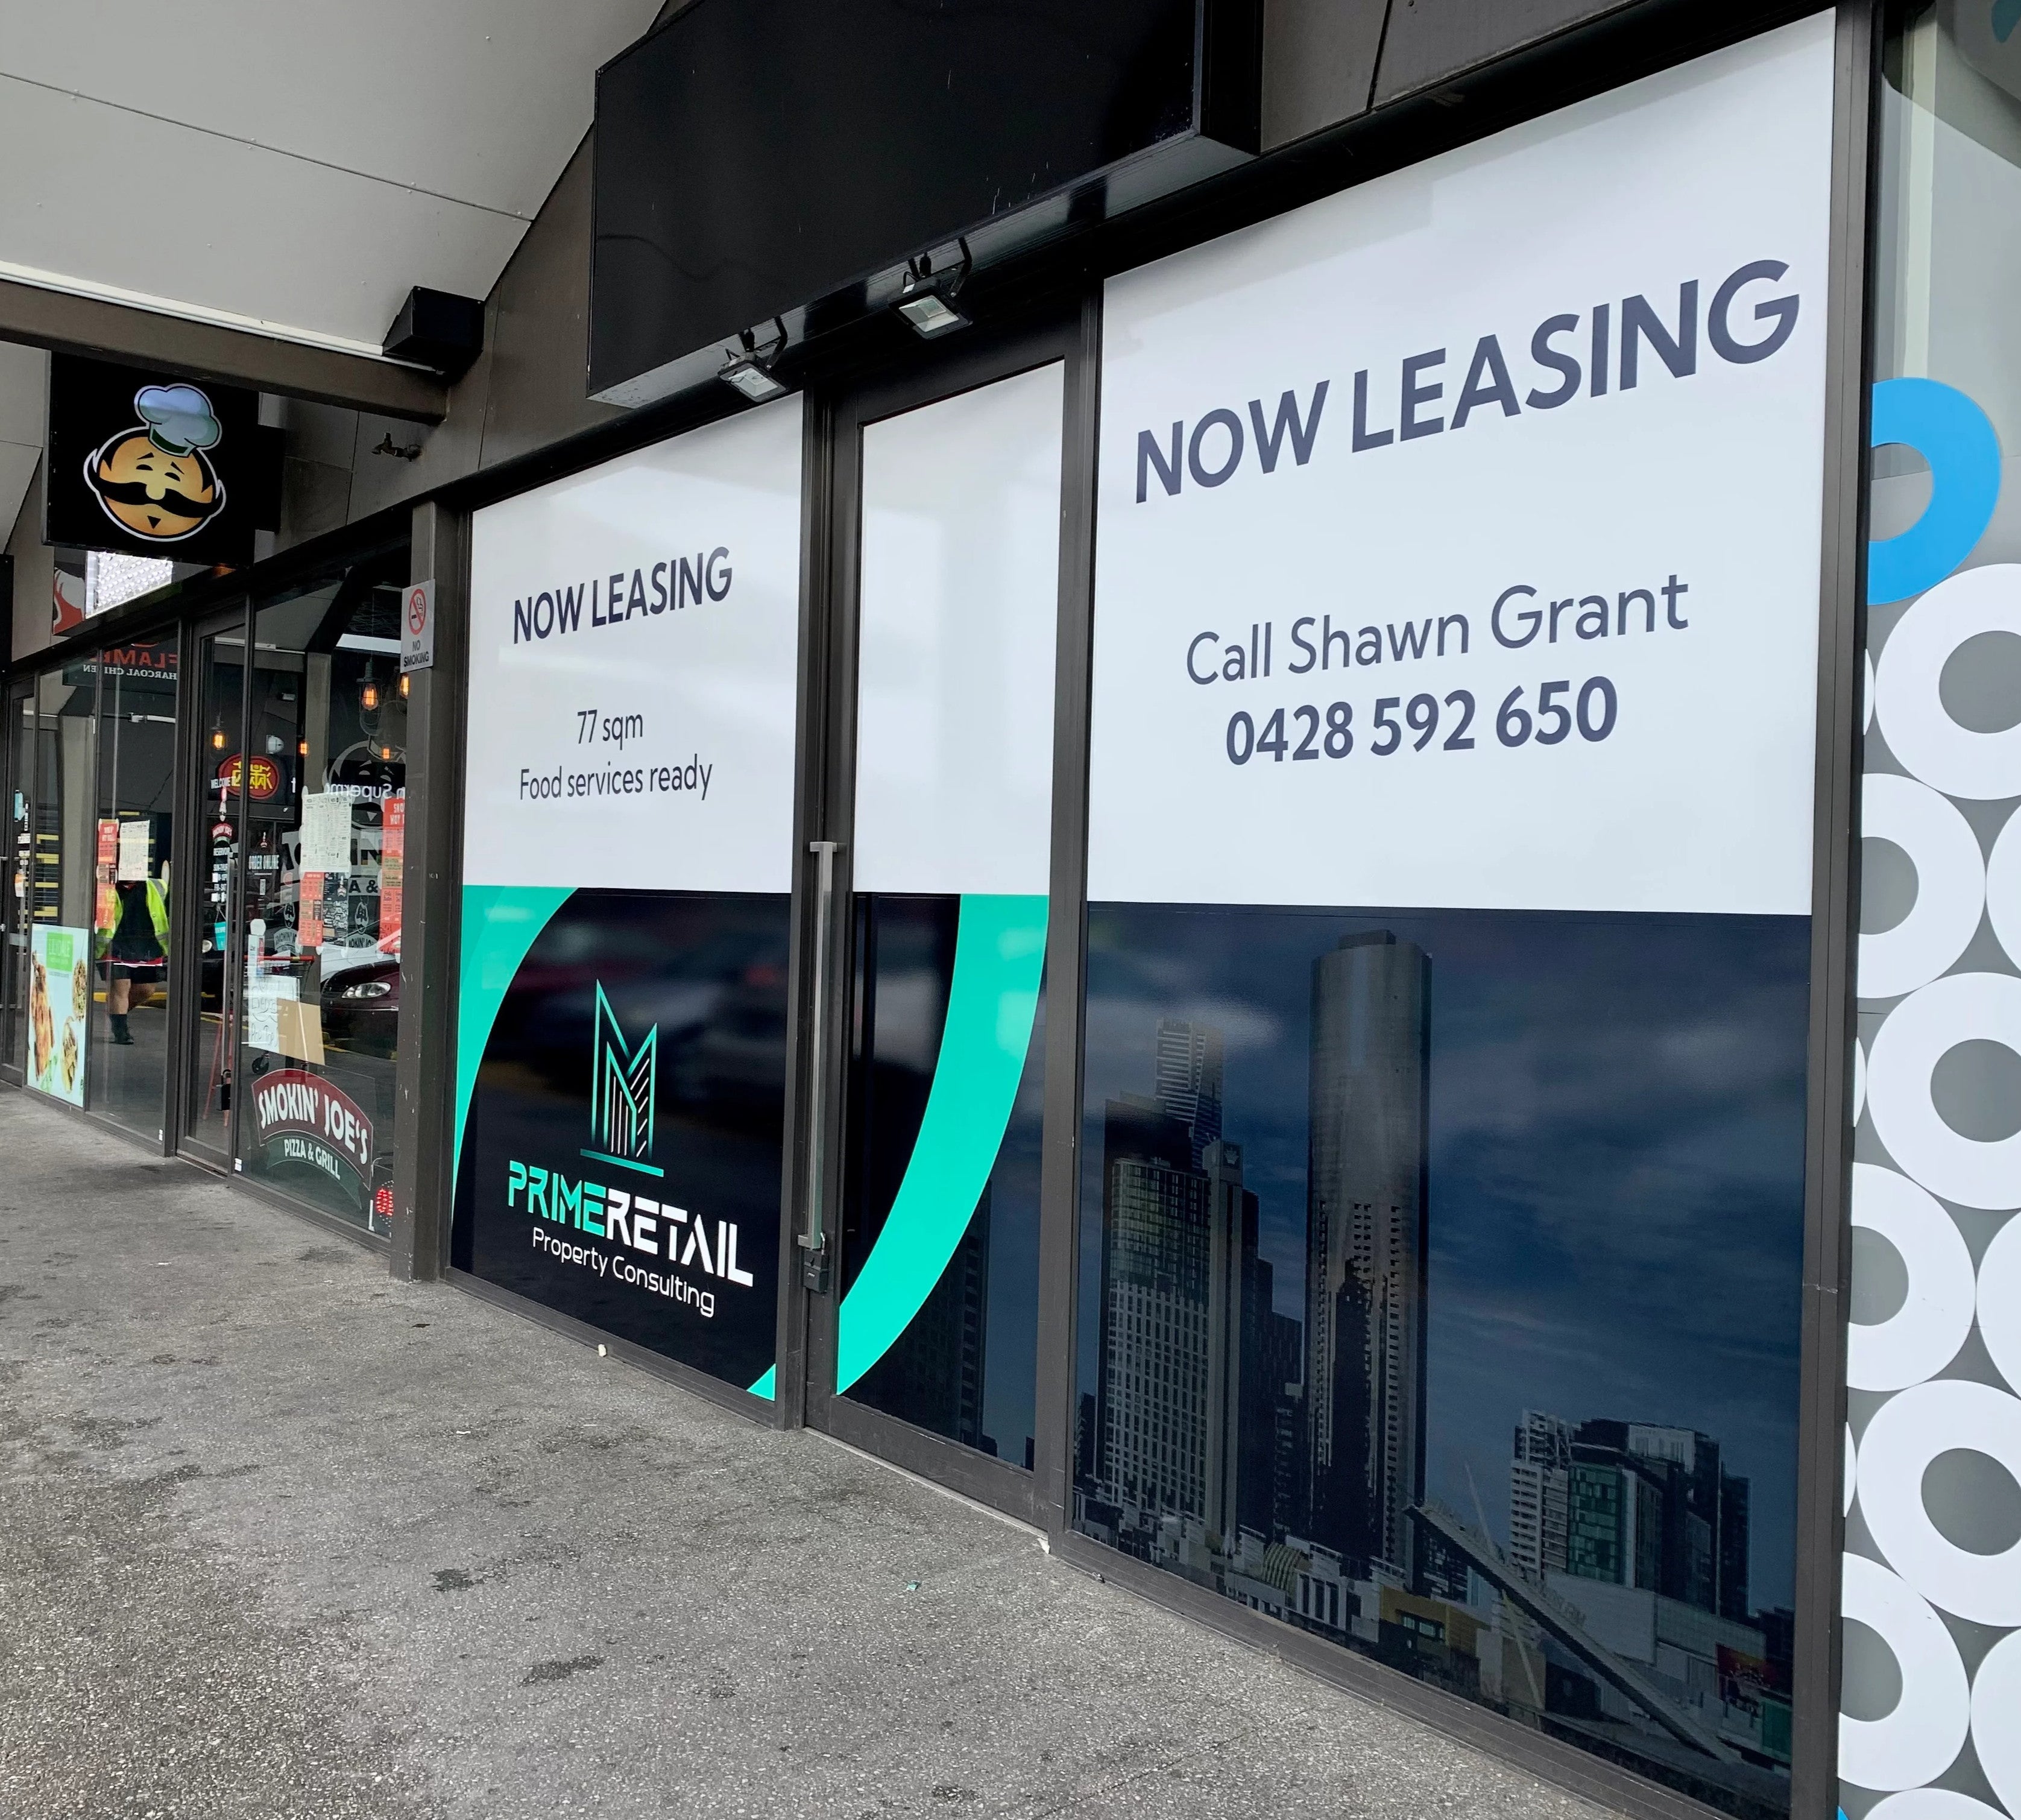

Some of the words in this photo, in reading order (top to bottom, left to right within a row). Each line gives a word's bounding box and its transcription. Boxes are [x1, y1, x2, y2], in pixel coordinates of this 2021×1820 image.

[1136, 379, 1331, 504] NOW
[1352, 259, 1800, 453] LEASING
[514, 583, 585, 645] NOW
[591, 546, 733, 628] LEASING
[1187, 622, 1272, 685] Call
[1288, 614, 1469, 674] Shawn
[1491, 574, 1689, 649] Grant
[403, 651, 430, 668] SMOKING
[412, 640, 421, 652] NO
[577, 709, 597, 744] 77
[602, 714, 643, 751] sqm
[1226, 701, 1354, 766] 0428
[1370, 689, 1475, 756] 592
[1496, 676, 1618, 748] 650
[520, 765, 562, 800] Food
[567, 760, 643, 797] services
[650, 753, 713, 801] ready
[258, 1083, 319, 1130] SMOKIN'
[324, 1093, 368, 1164] JOE'S
[284, 1138, 306, 1159] PIZZA
[307, 1142, 314, 1161] &
[315, 1146, 341, 1180] GRILL
[532, 1227, 608, 1277] Property
[612, 1256, 715, 1318] Consulting
